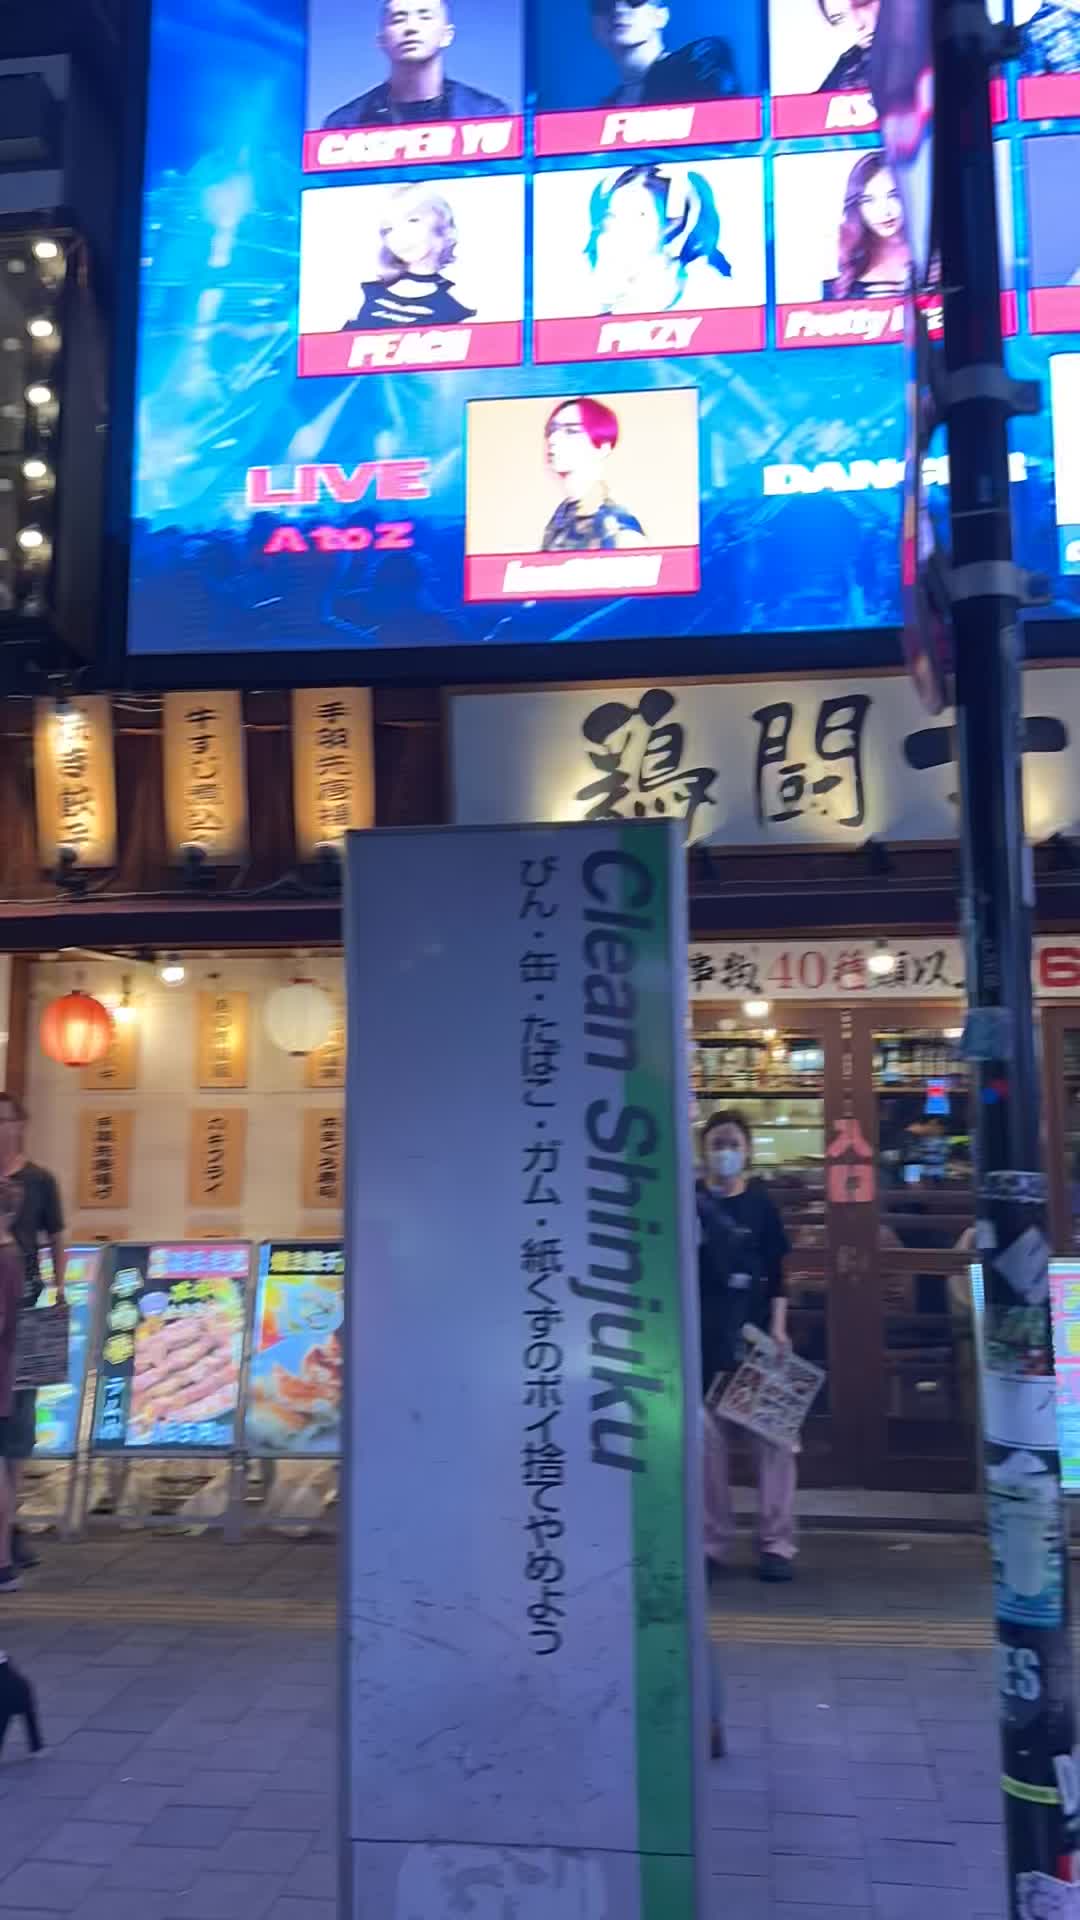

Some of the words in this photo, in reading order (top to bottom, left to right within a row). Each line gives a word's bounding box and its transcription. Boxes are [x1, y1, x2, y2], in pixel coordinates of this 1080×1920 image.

[246, 457, 430, 507] LIVE
[263, 525, 310, 554] A
[309, 524, 373, 552] to
[373, 520, 415, 550] Z
[581, 849, 656, 1071] Clean
[567, 1097, 666, 1474] Shinjuku
